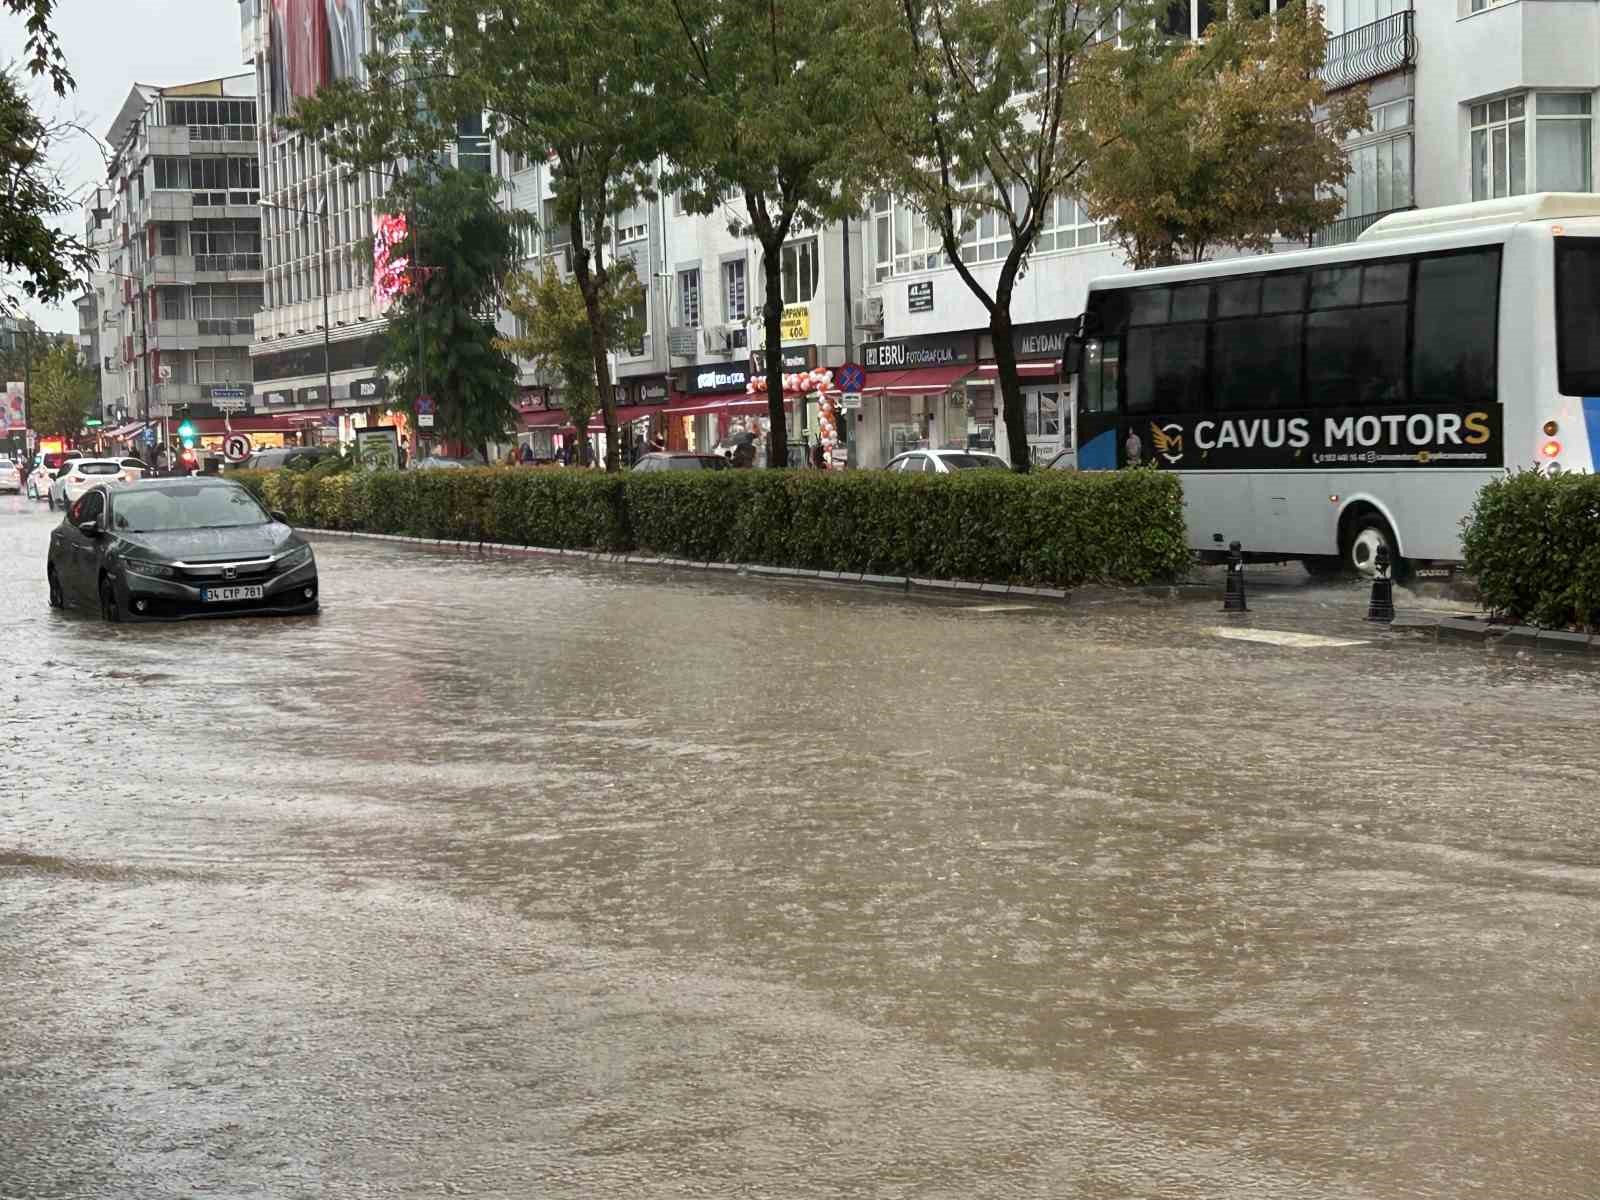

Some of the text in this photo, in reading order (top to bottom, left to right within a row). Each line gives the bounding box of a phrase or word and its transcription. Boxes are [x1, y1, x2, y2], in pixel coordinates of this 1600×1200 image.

[1022, 334, 1064, 352] MEYDAN
[879, 344, 905, 365] EBRU
[1324, 412, 1490, 447] MOTORS
[208, 590, 219, 600] 34
[244, 586, 261, 597] 781
